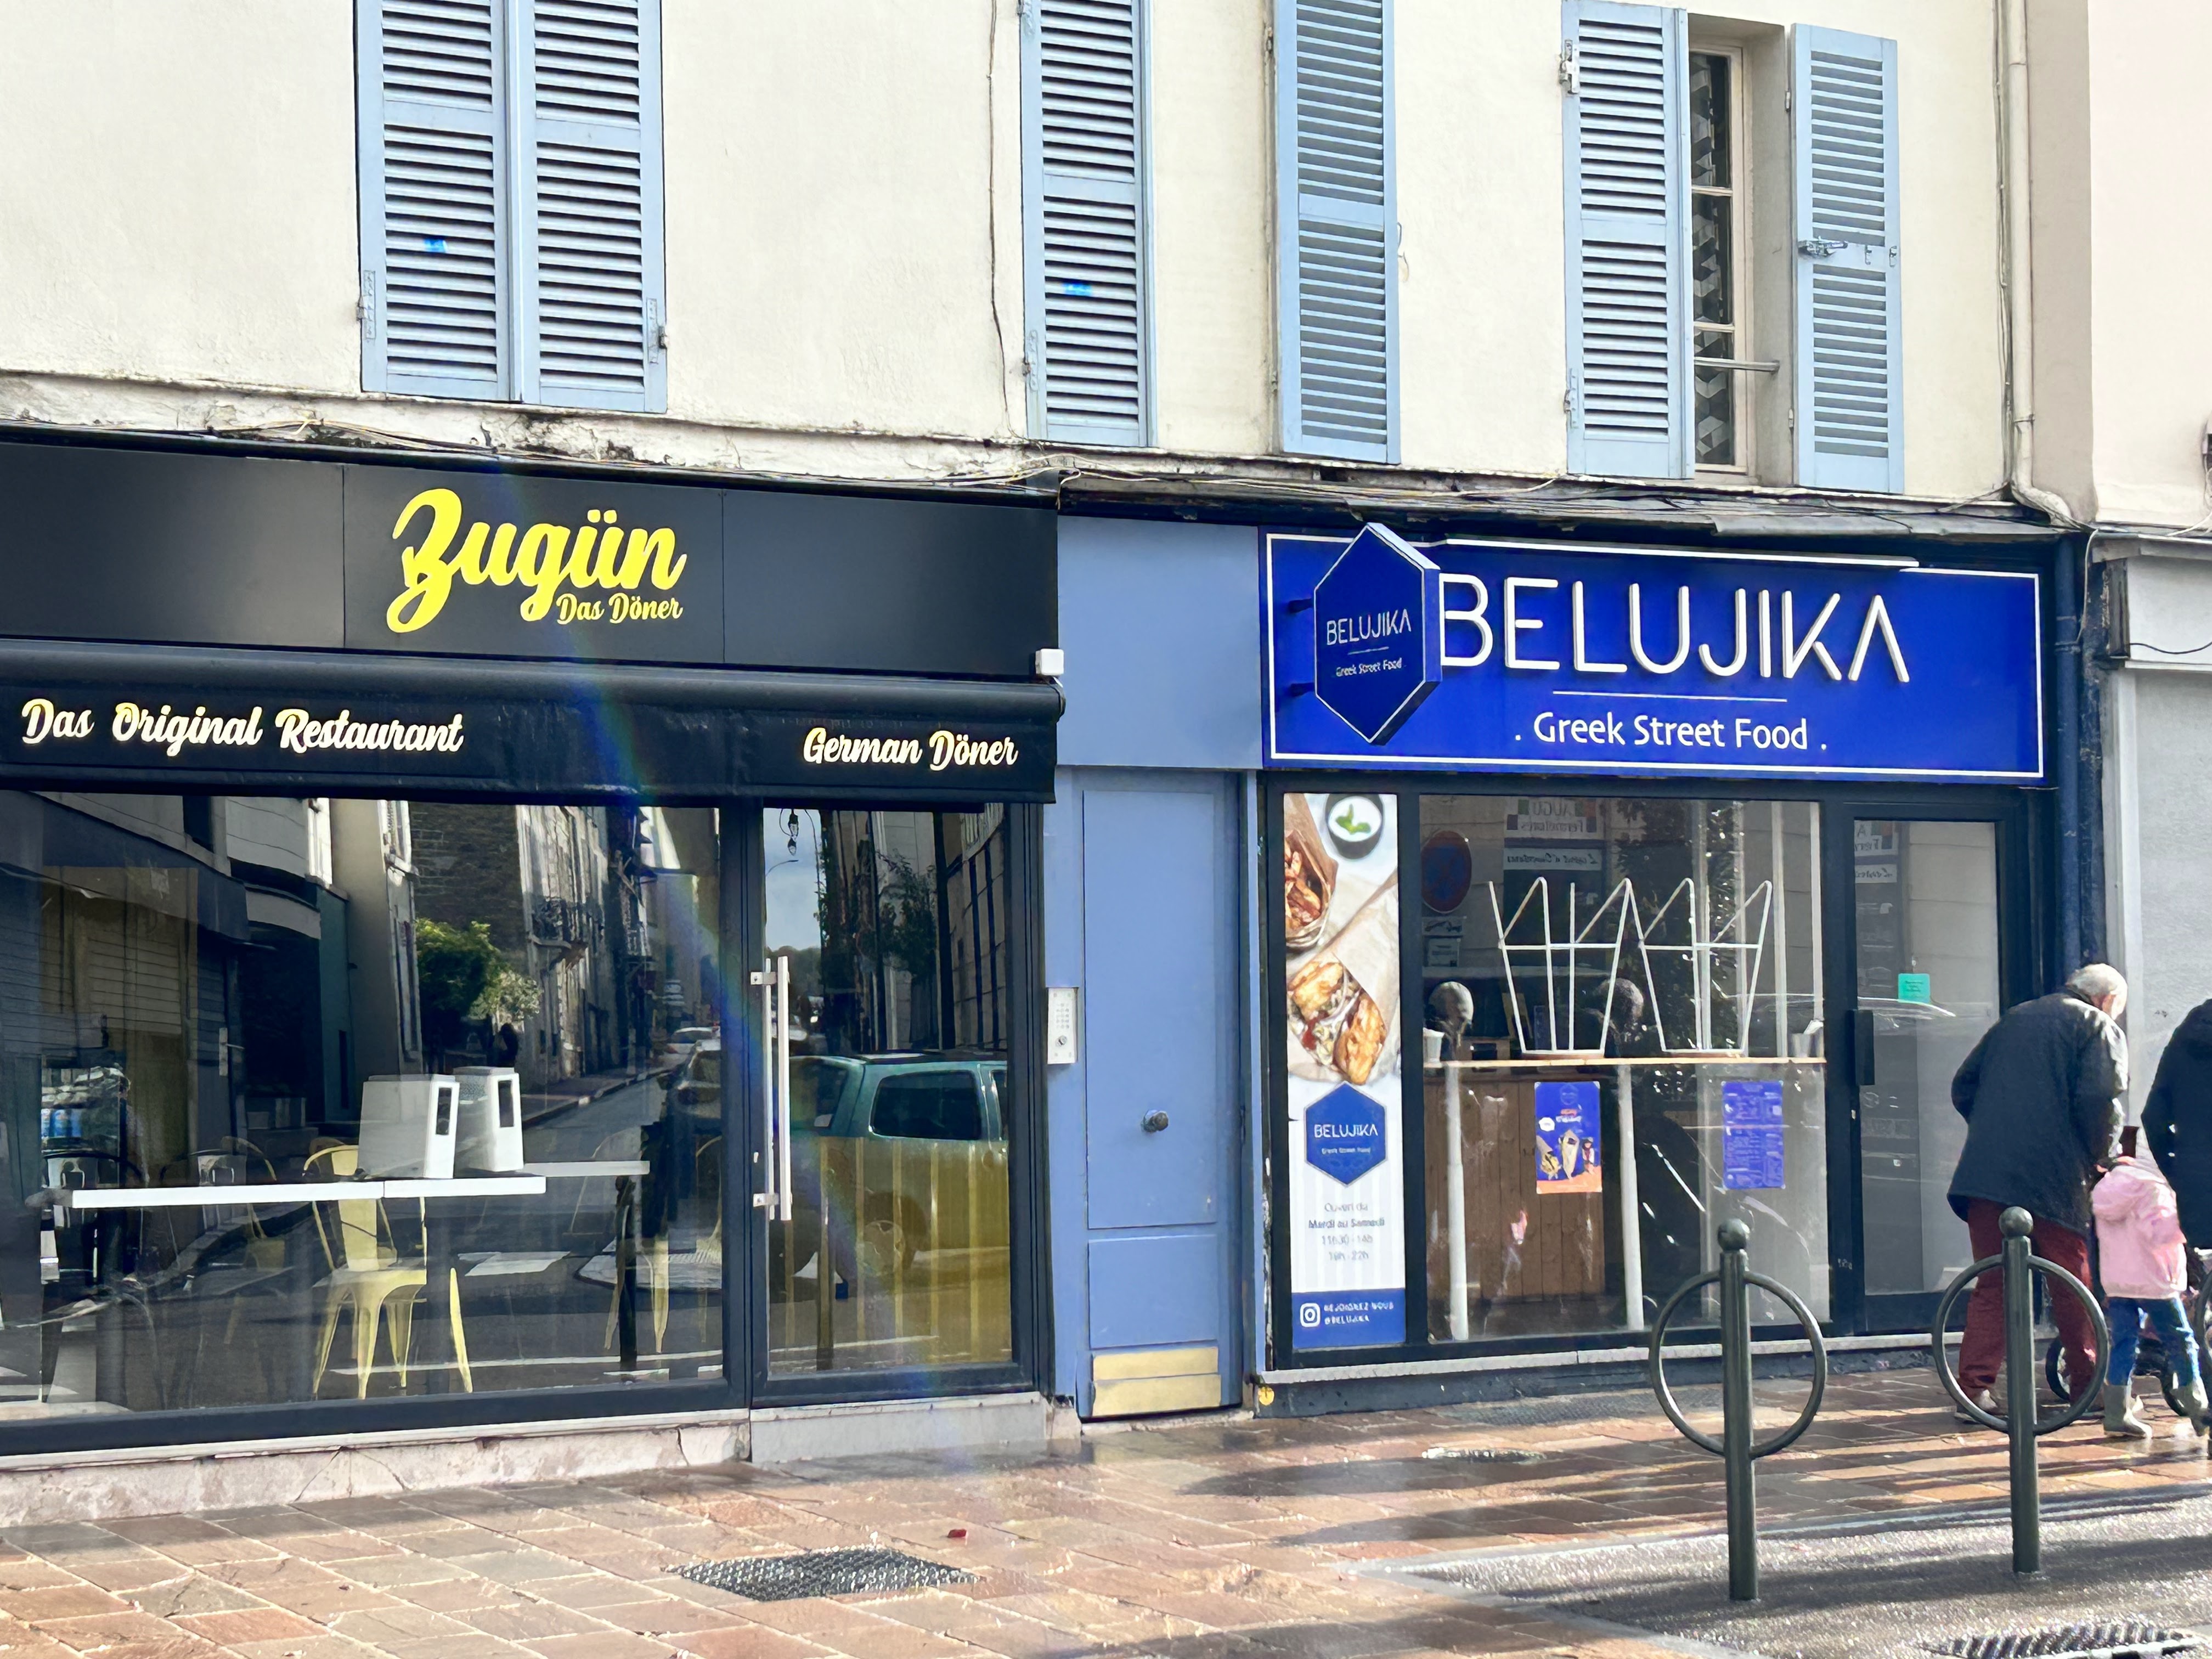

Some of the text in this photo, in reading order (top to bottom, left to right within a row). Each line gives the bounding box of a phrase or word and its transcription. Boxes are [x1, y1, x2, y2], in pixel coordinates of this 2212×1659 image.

[556, 592, 683, 624] Das Döner
[1327, 609, 1412, 646] BELUJIKA
[1438, 572, 1910, 684] BELUJIKA
[22, 698, 464, 757] Das Original Restaurant
[1533, 711, 1808, 750] Greek Street Food
[804, 727, 1018, 771] German Döner
[1314, 1123, 1379, 1138] BELUJIKA
